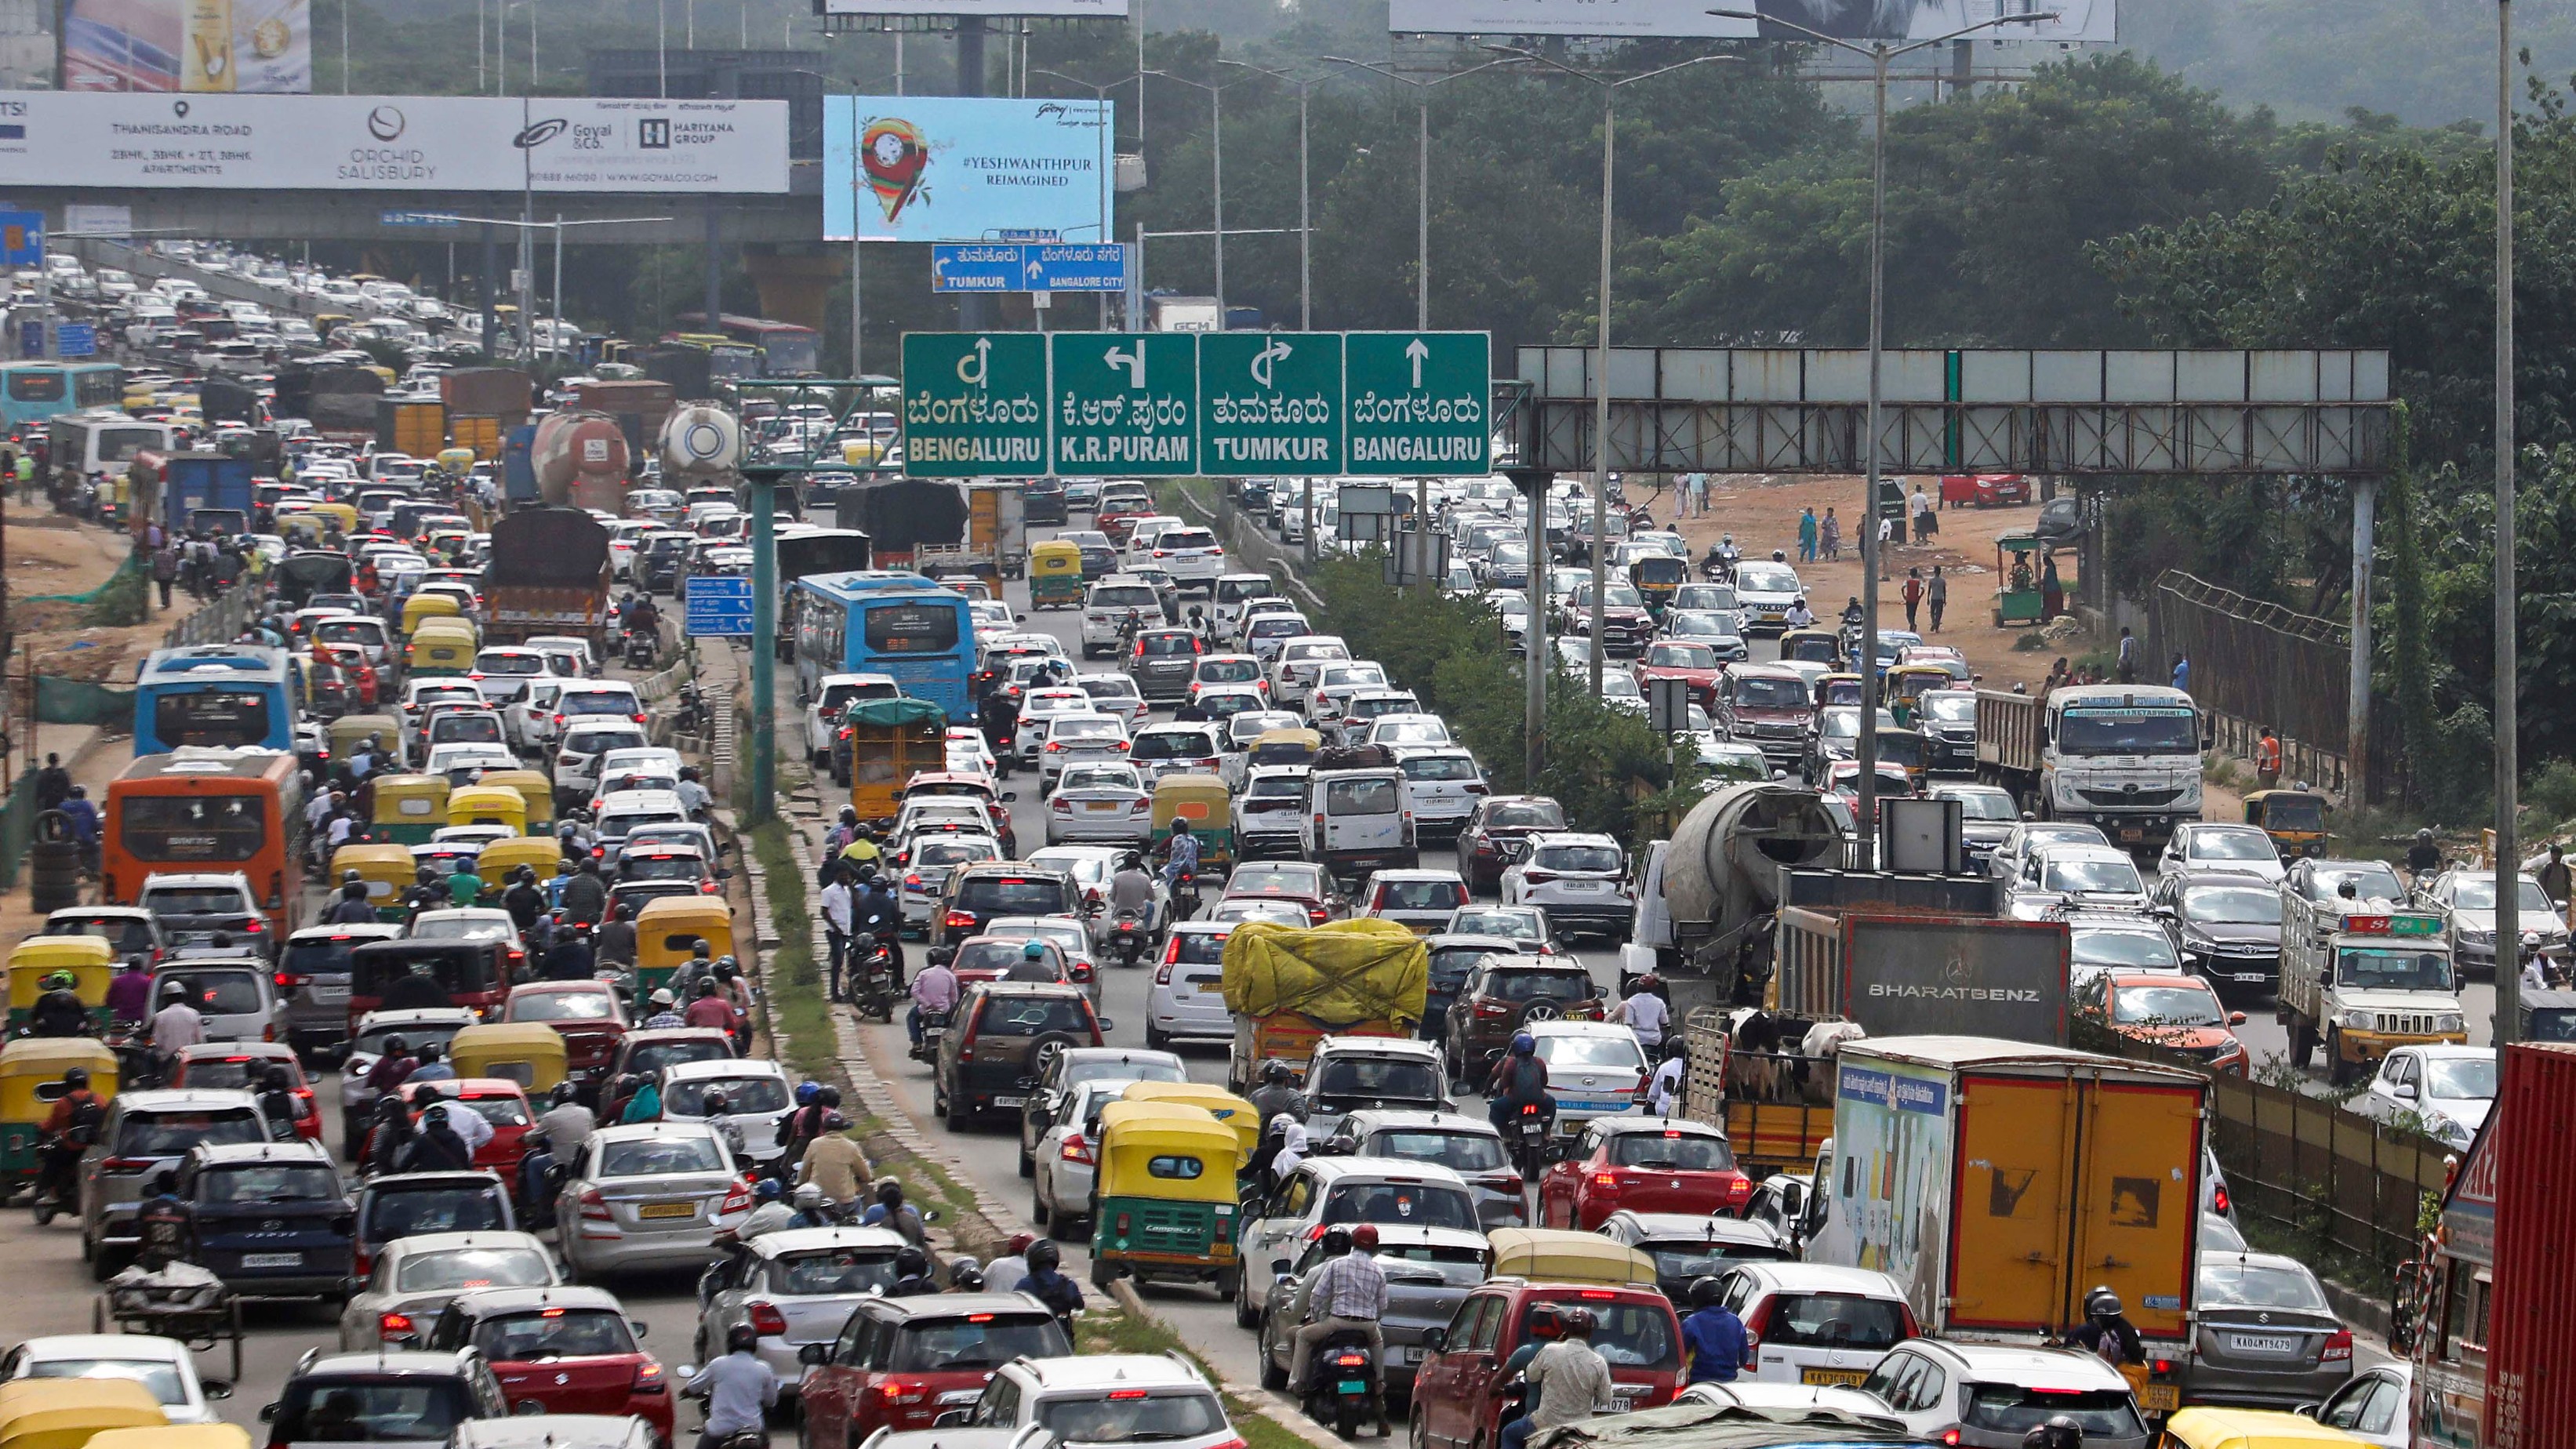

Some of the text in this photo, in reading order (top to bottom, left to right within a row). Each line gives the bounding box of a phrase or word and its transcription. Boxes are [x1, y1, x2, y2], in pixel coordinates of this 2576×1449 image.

[112, 124, 253, 136] THANISANDRA ROAD
[572, 125, 612, 137] Goyal
[674, 123, 735, 133] HARIYANA
[674, 135, 715, 144] GROUP
[351, 149, 424, 164] ORCHID
[963, 157, 1092, 171] #YESHWANTHPUR
[141, 164, 222, 174] APARTMENTS
[338, 165, 437, 180] SALISBURY
[986, 175, 1069, 187] REIMAGINED
[957, 248, 1018, 263] ತುಮಕೂರು
[947, 277, 1005, 288] TUMKUR
[1049, 277, 1123, 287] BANGALORE CITY
[908, 390, 1039, 424] ಬೆಂಗಳೂರು
[1213, 391, 1329, 424] ತುಮಕೂರು
[1354, 390, 1481, 423] ಬೆಂಗಳೂರು
[909, 437, 1040, 462] BENGALURU
[1061, 436, 1189, 462] K.R.PURAM
[1213, 437, 1329, 461] TUMKUR
[1353, 437, 1481, 461] BANGALURU
[1868, 984, 2040, 1002] BHARATBENZ
[2236, 1336, 2291, 1350] KA04MT9479
